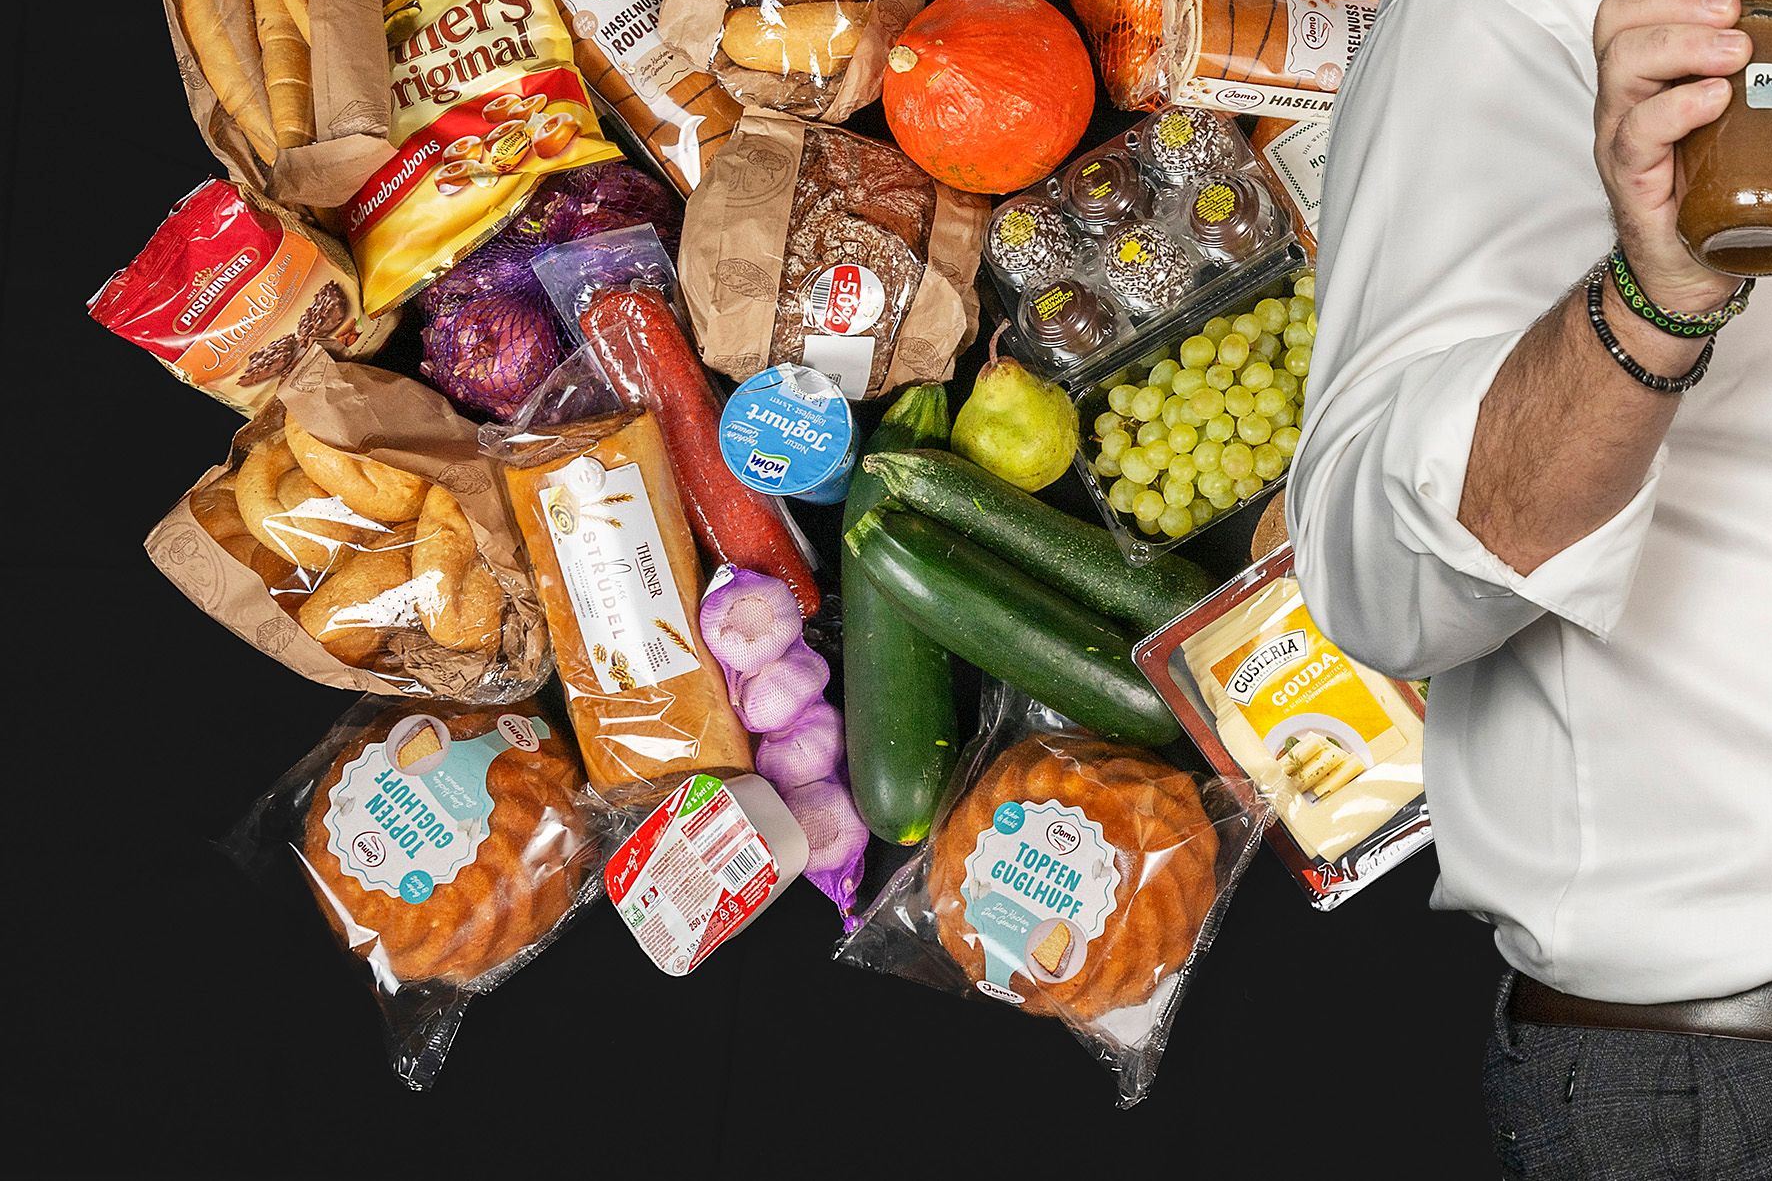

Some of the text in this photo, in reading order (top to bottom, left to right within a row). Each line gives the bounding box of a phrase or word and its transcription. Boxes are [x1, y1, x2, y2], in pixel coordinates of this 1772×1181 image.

[1306, 16, 1317, 42] Jomo
[391, 22, 539, 110] riginal
[1225, 90, 1257, 101] Jomo
[350, 139, 441, 232] Sahnebonbons
[180, 254, 252, 327] PISCHINGER
[832, 273, 858, 326] -50%
[203, 281, 282, 371] Mandel
[746, 403, 833, 452] Joghurt
[784, 439, 810, 454] Natur
[582, 530, 628, 642] STRUDEL
[635, 541, 663, 600] THURNER
[1233, 637, 1300, 696] GUSTERIA
[1270, 650, 1341, 708] GOUDA
[501, 718, 535, 747] Jomo
[364, 793, 418, 860] TOPFEN
[374, 773, 454, 851] GUGLHUPF
[1051, 823, 1077, 844] Jomo
[355, 838, 383, 868] Jomo
[1014, 841, 1083, 891] TOPFEN
[990, 859, 1085, 920] GUGLHUPF
[689, 916, 704, 932] 250
[981, 983, 1019, 1000] Jomo
